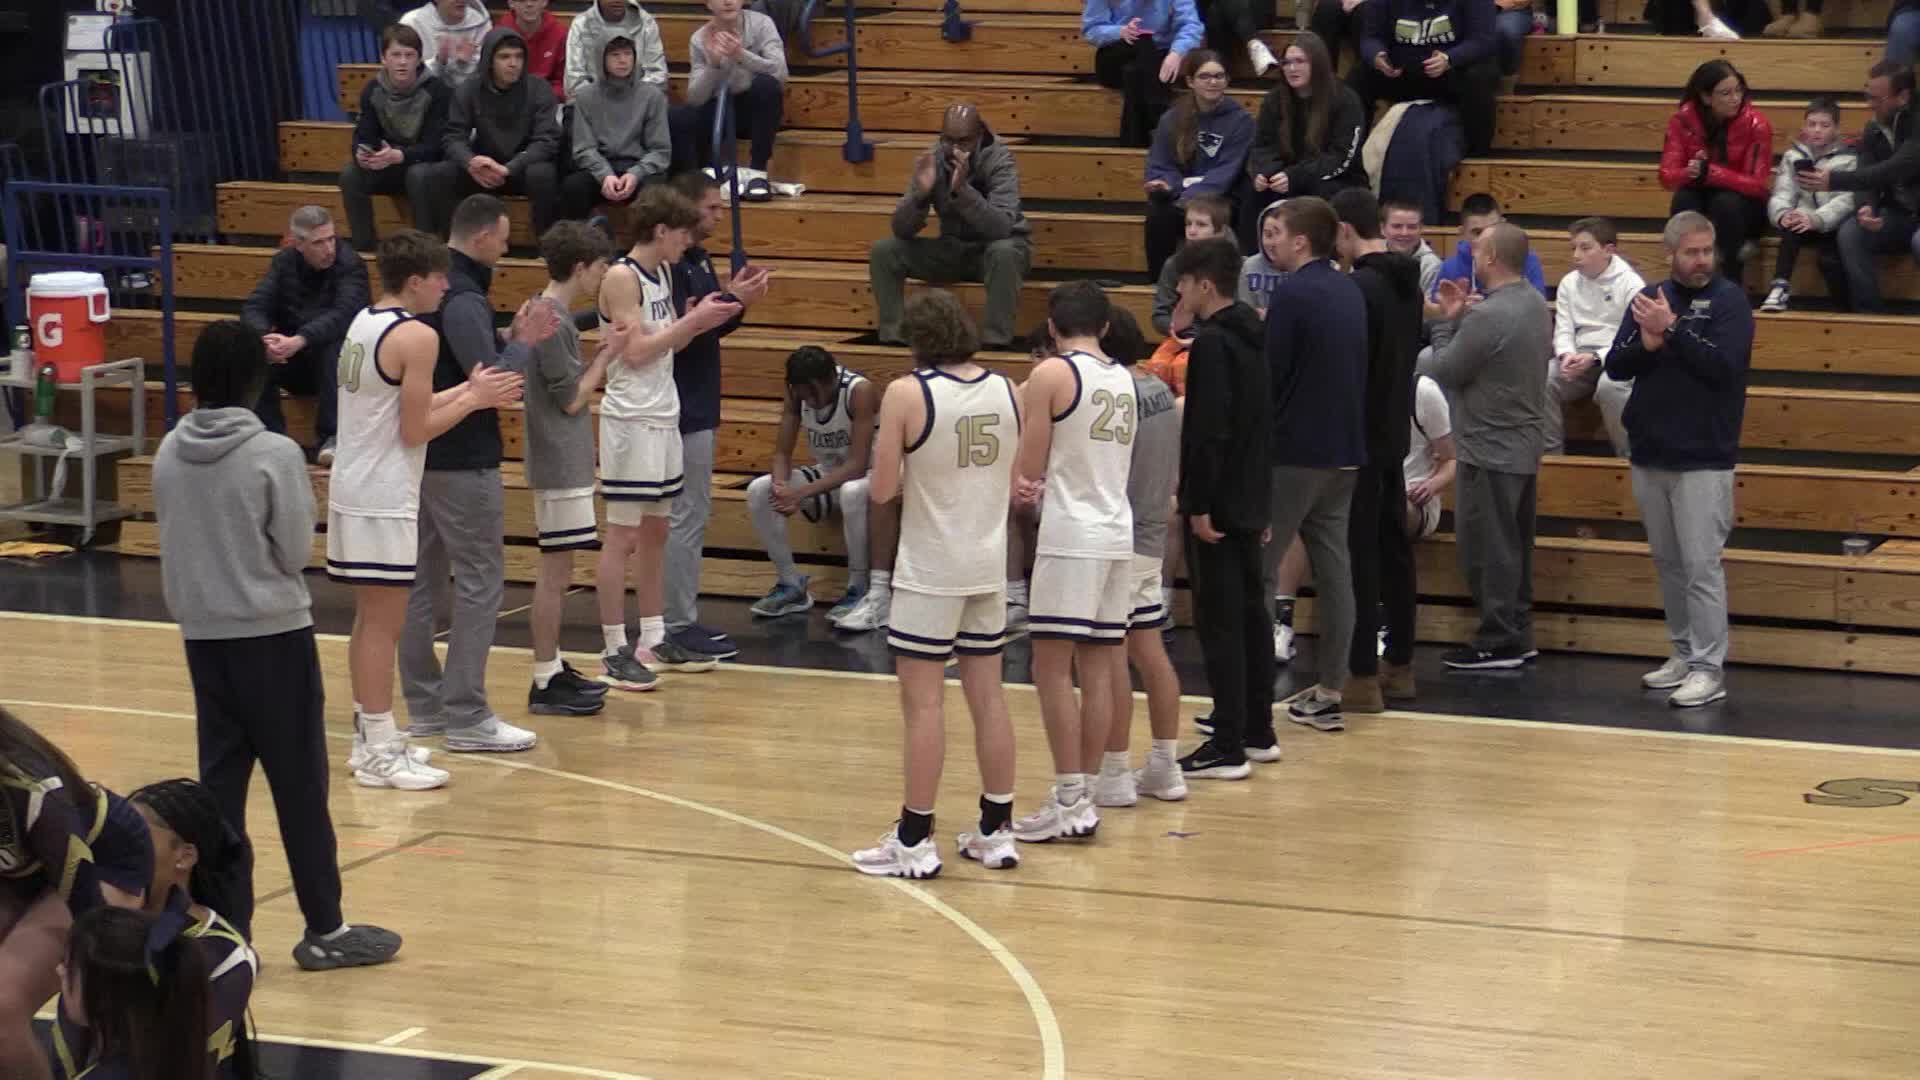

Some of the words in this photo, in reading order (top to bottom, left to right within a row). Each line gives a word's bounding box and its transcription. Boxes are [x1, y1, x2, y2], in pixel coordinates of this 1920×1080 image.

[38, 313, 63, 348] G
[955, 413, 1000, 468] 15
[1090, 389, 1134, 445] 23
